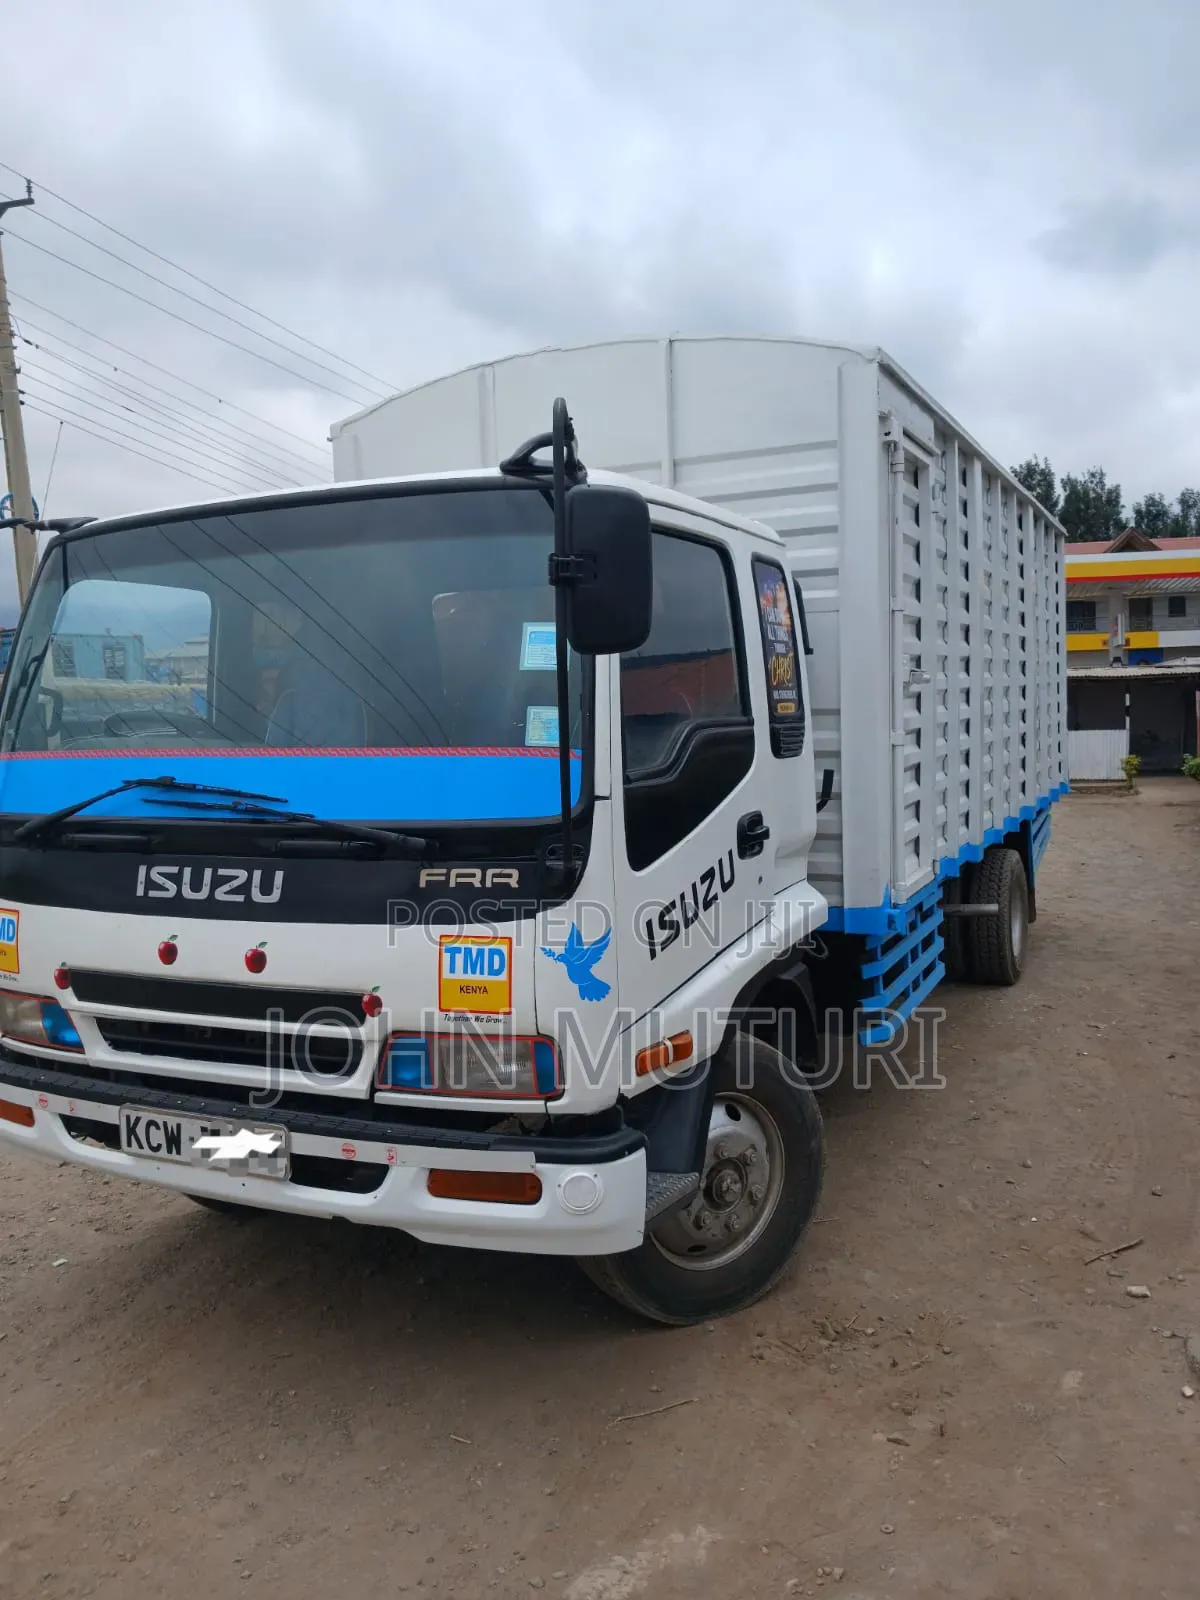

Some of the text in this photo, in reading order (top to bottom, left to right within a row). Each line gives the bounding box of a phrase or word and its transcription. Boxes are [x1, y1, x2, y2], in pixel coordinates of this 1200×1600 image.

[771, 652, 794, 686] CHRIST
[136, 864, 285, 904] ISUZU
[419, 867, 520, 889] FRR
[645, 848, 735, 961] ISUZU
[444, 945, 506, 977] TMD
[459, 984, 489, 995] KENYA
[125, 1114, 182, 1156] KCW
